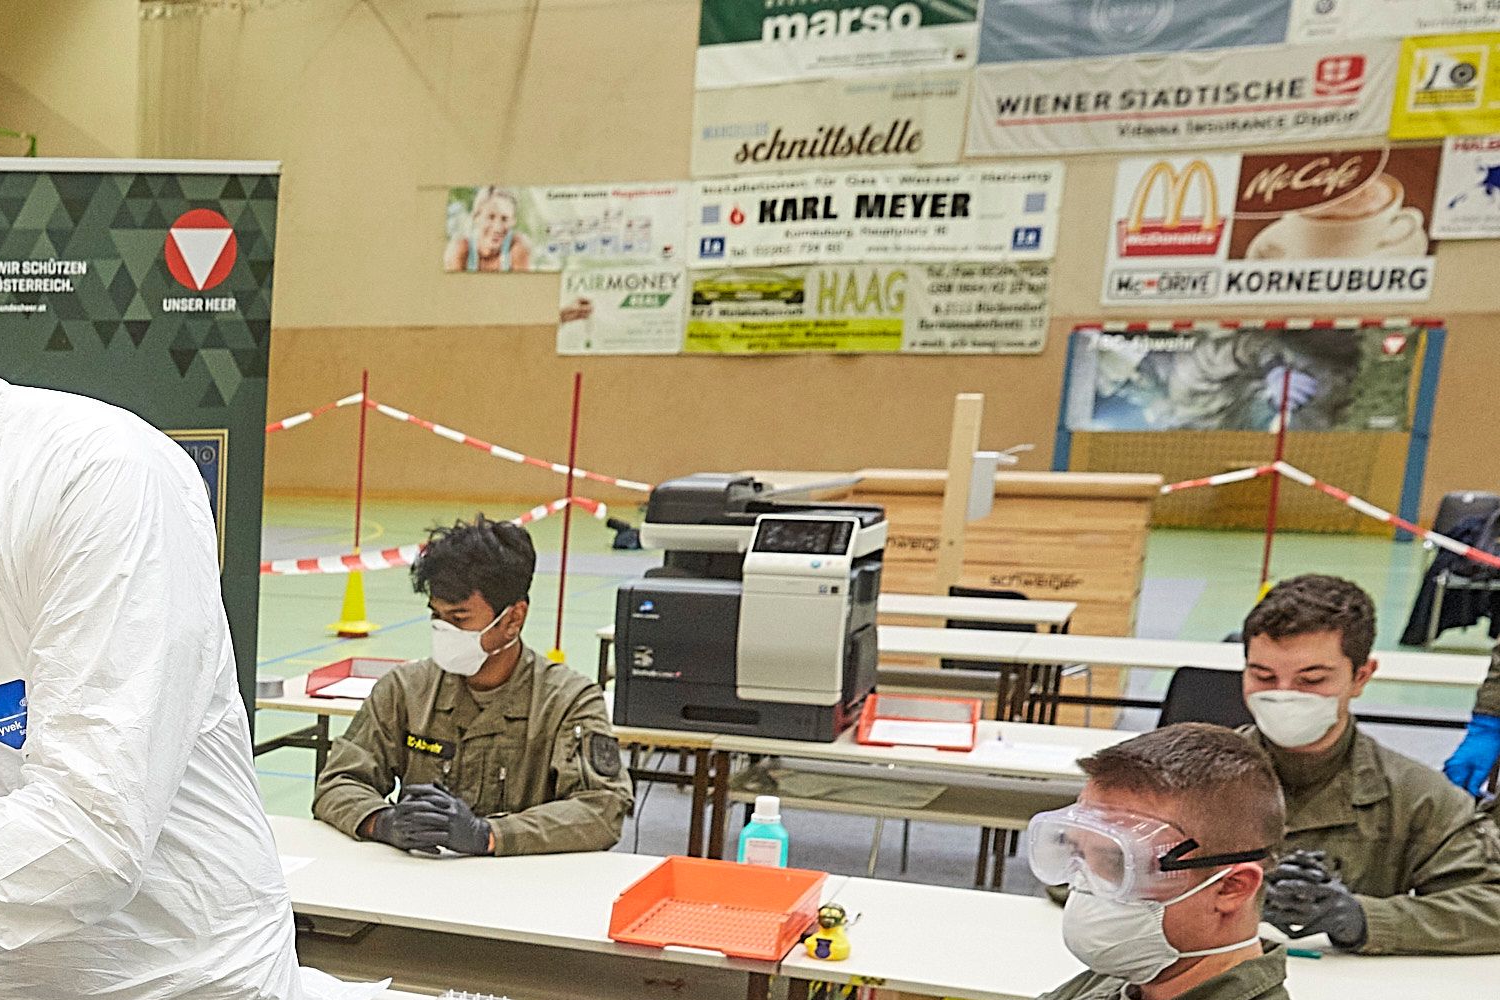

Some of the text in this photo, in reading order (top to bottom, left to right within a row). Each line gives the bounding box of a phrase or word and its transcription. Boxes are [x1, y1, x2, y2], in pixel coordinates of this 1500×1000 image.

[761, 3, 922, 42] marso
[997, 90, 1113, 116] WIENER
[734, 118, 923, 163] schnittstelle
[759, 193, 971, 224] KARL MEYER
[22, 257, 87, 275] SCHÜTZEN
[817, 269, 908, 313] HAAG
[1226, 268, 1428, 293] KORNEUBURG
[163, 297, 237, 312] UNSER HEER
